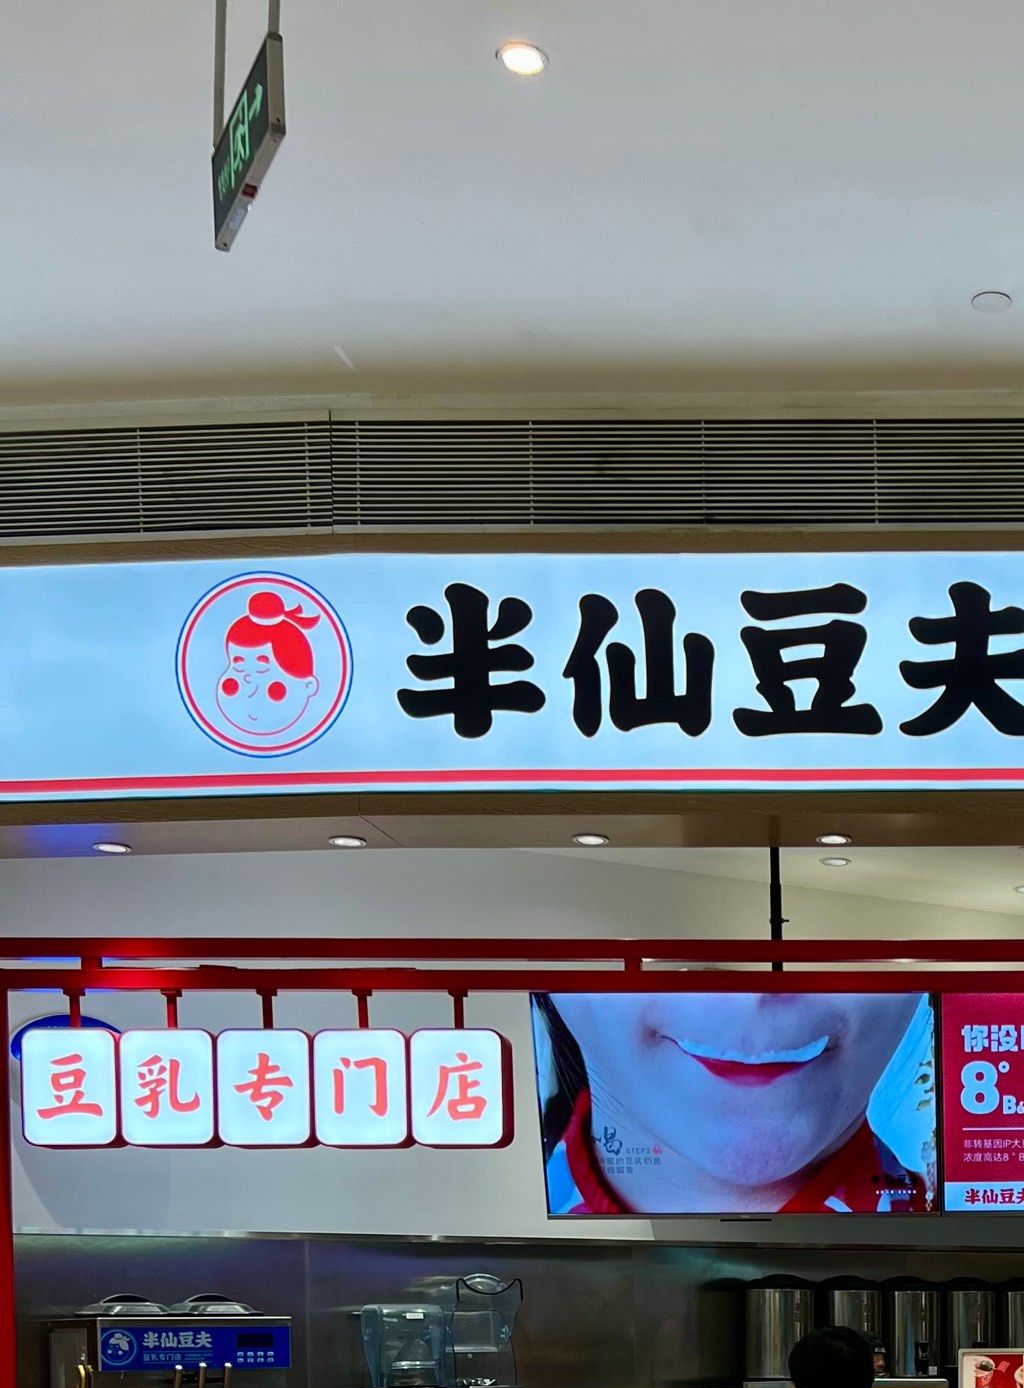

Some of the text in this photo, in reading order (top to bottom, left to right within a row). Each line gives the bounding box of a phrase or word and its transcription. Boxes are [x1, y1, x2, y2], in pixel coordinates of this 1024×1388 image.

[37, 1052, 488, 1121] 豆乳专门店
[143, 1331, 213, 1348] 半仙豆夫
